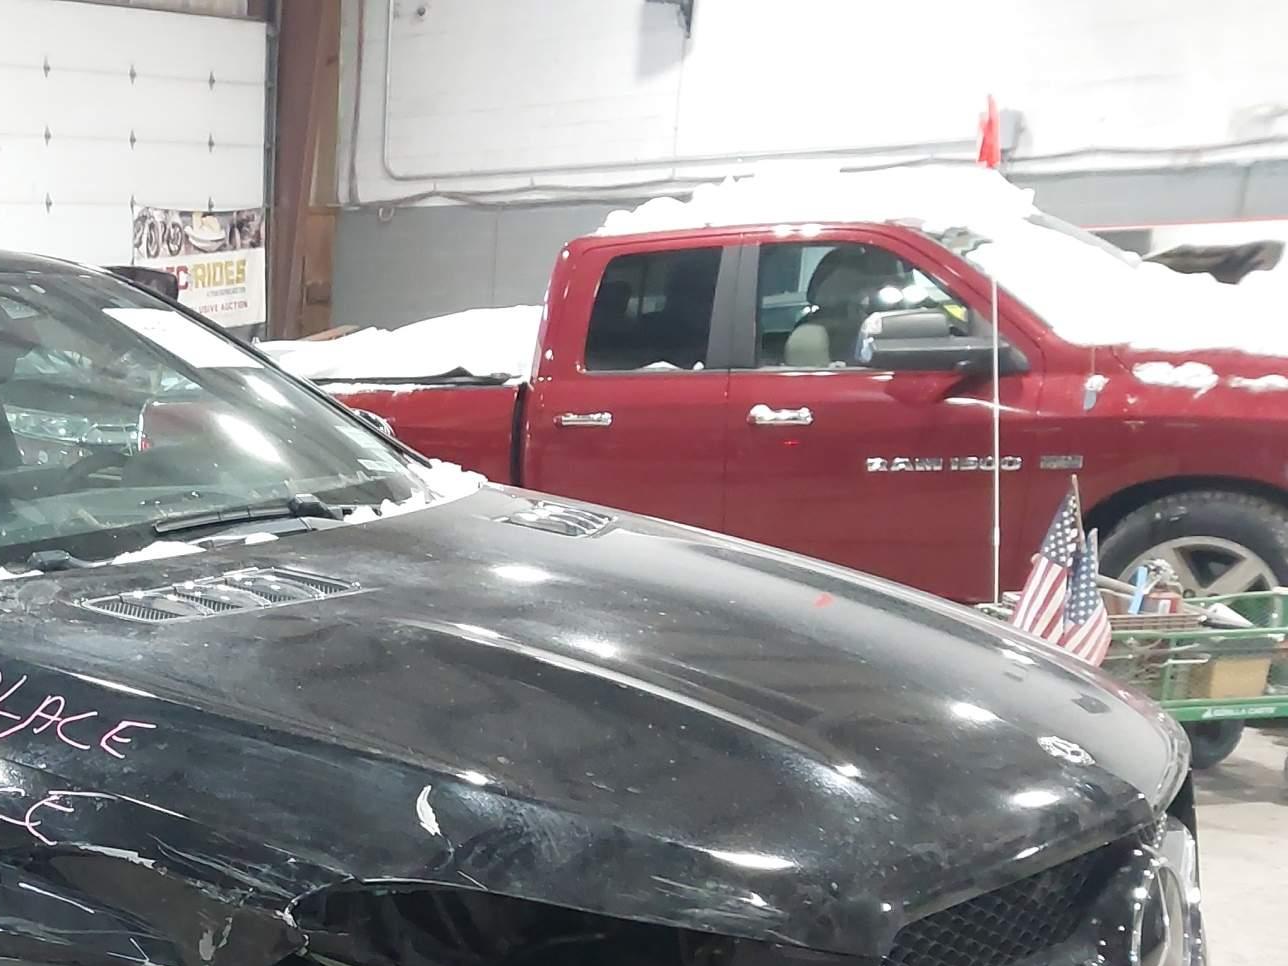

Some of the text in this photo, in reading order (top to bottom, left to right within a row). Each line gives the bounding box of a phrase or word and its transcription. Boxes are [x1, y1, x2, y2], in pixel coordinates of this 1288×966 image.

[194, 259, 246, 289] RIDES
[220, 300, 248, 312] AUCTION
[865, 456, 944, 472] RAM
[950, 455, 1023, 471] 1500
